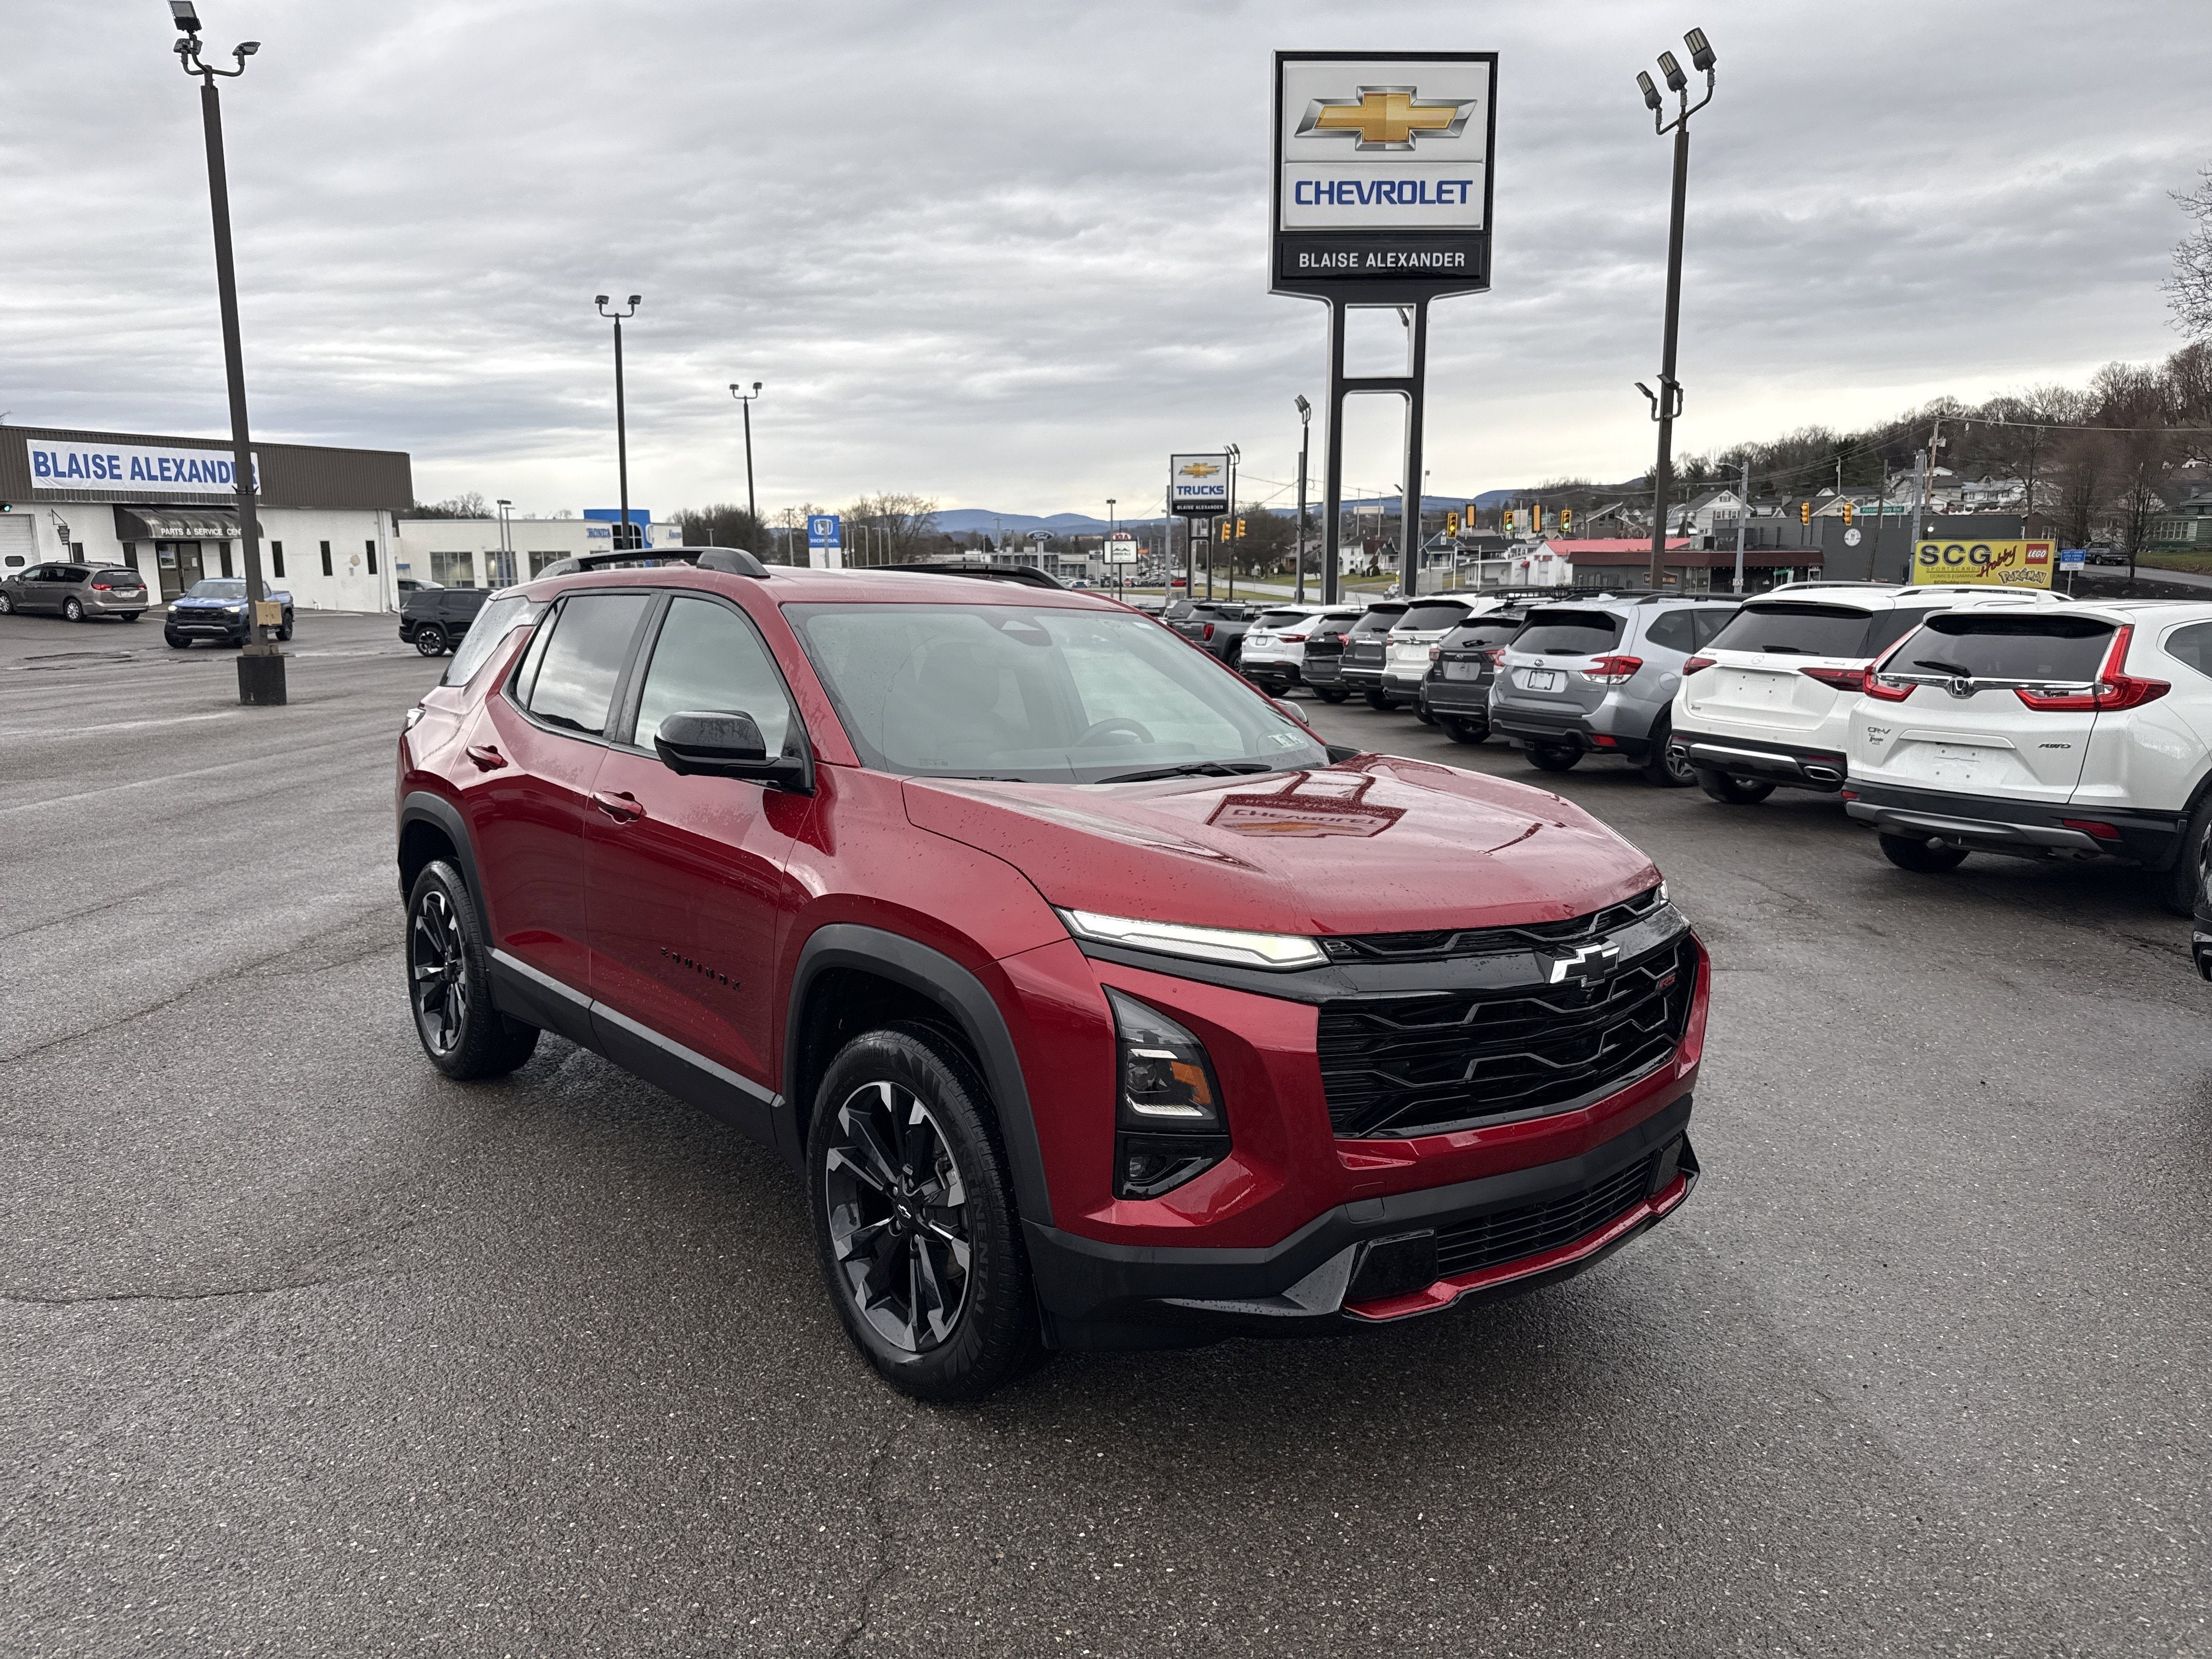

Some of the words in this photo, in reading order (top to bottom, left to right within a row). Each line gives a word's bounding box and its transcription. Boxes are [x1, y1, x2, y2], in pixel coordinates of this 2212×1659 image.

[1295, 180, 1473, 205] CHEVROLET
[1299, 253, 1358, 267] BLAISE
[1365, 252, 1465, 267] ALEXANDER
[32, 451, 122, 479] BLAISE
[1176, 486, 1224, 495] TRUCKS
[1918, 544, 1992, 566] SCG
[1976, 545, 2017, 577] Hobby
[2027, 549, 2047, 558] LEGO
